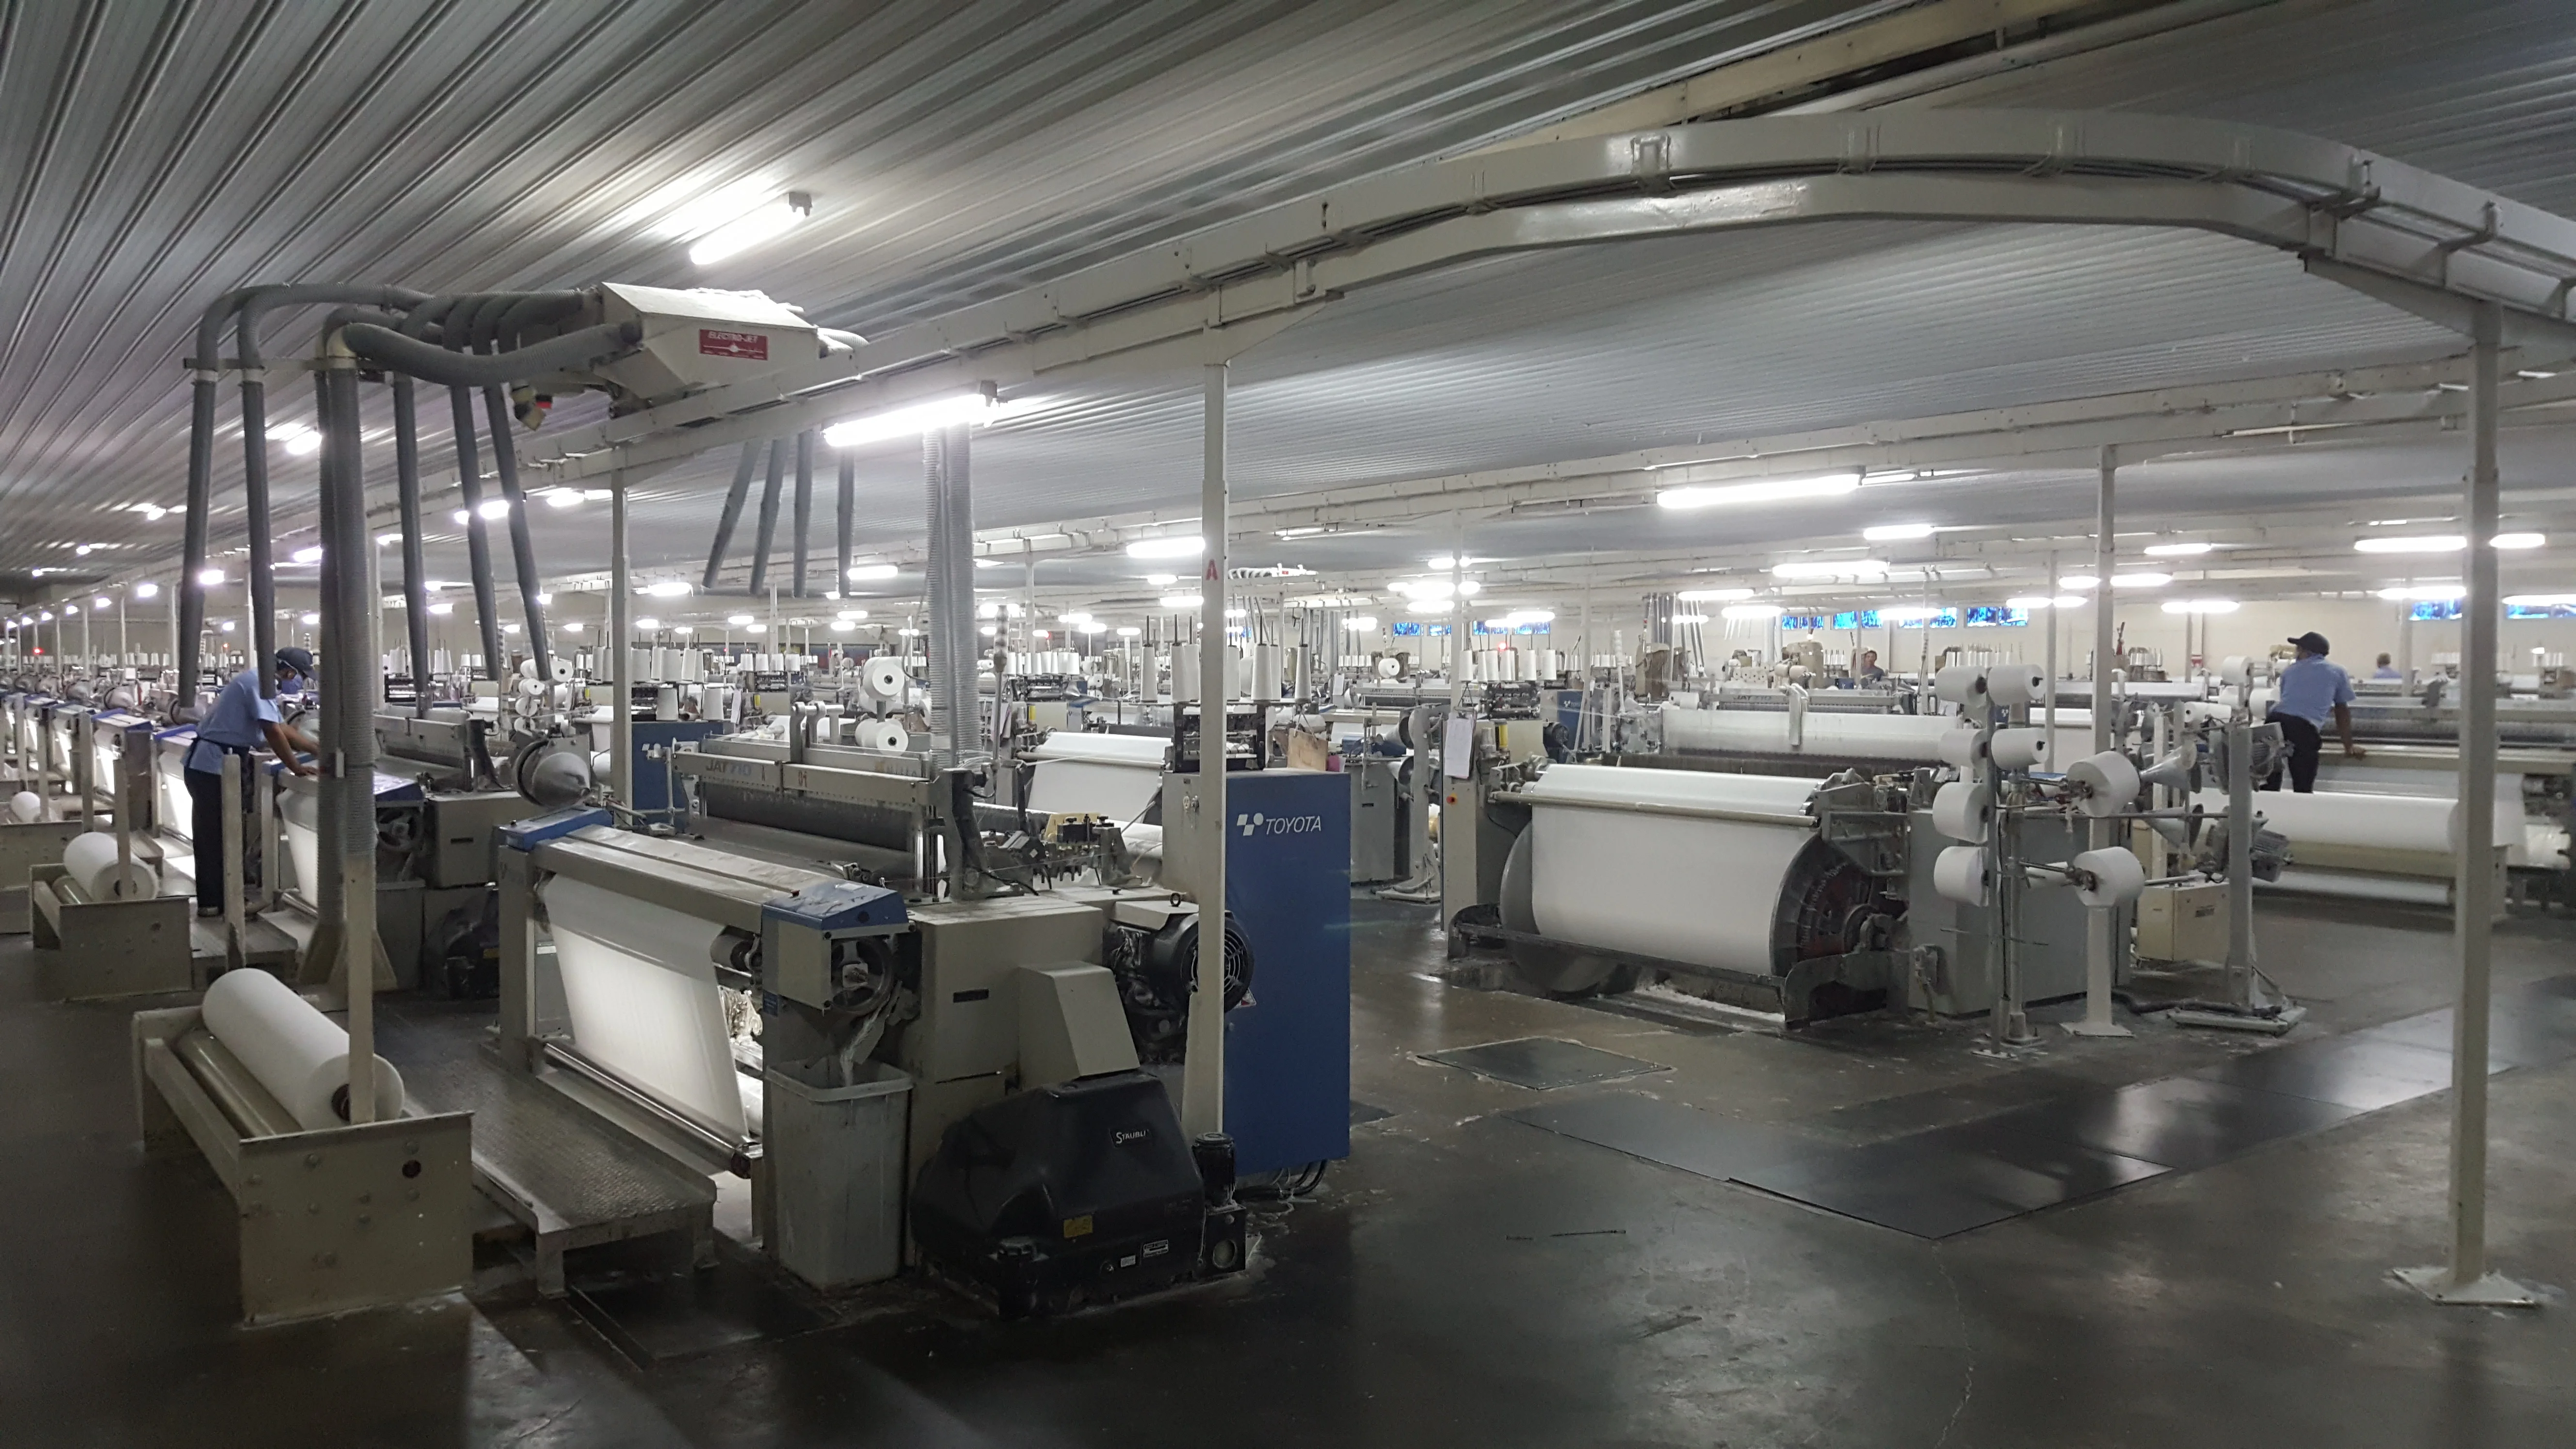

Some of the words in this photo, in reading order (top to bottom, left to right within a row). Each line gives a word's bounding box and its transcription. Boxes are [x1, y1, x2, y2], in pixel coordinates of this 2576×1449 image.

[1206, 559, 1219, 580] A
[706, 758, 728, 773] JAT
[1266, 816, 1321, 835] TOYOTA
